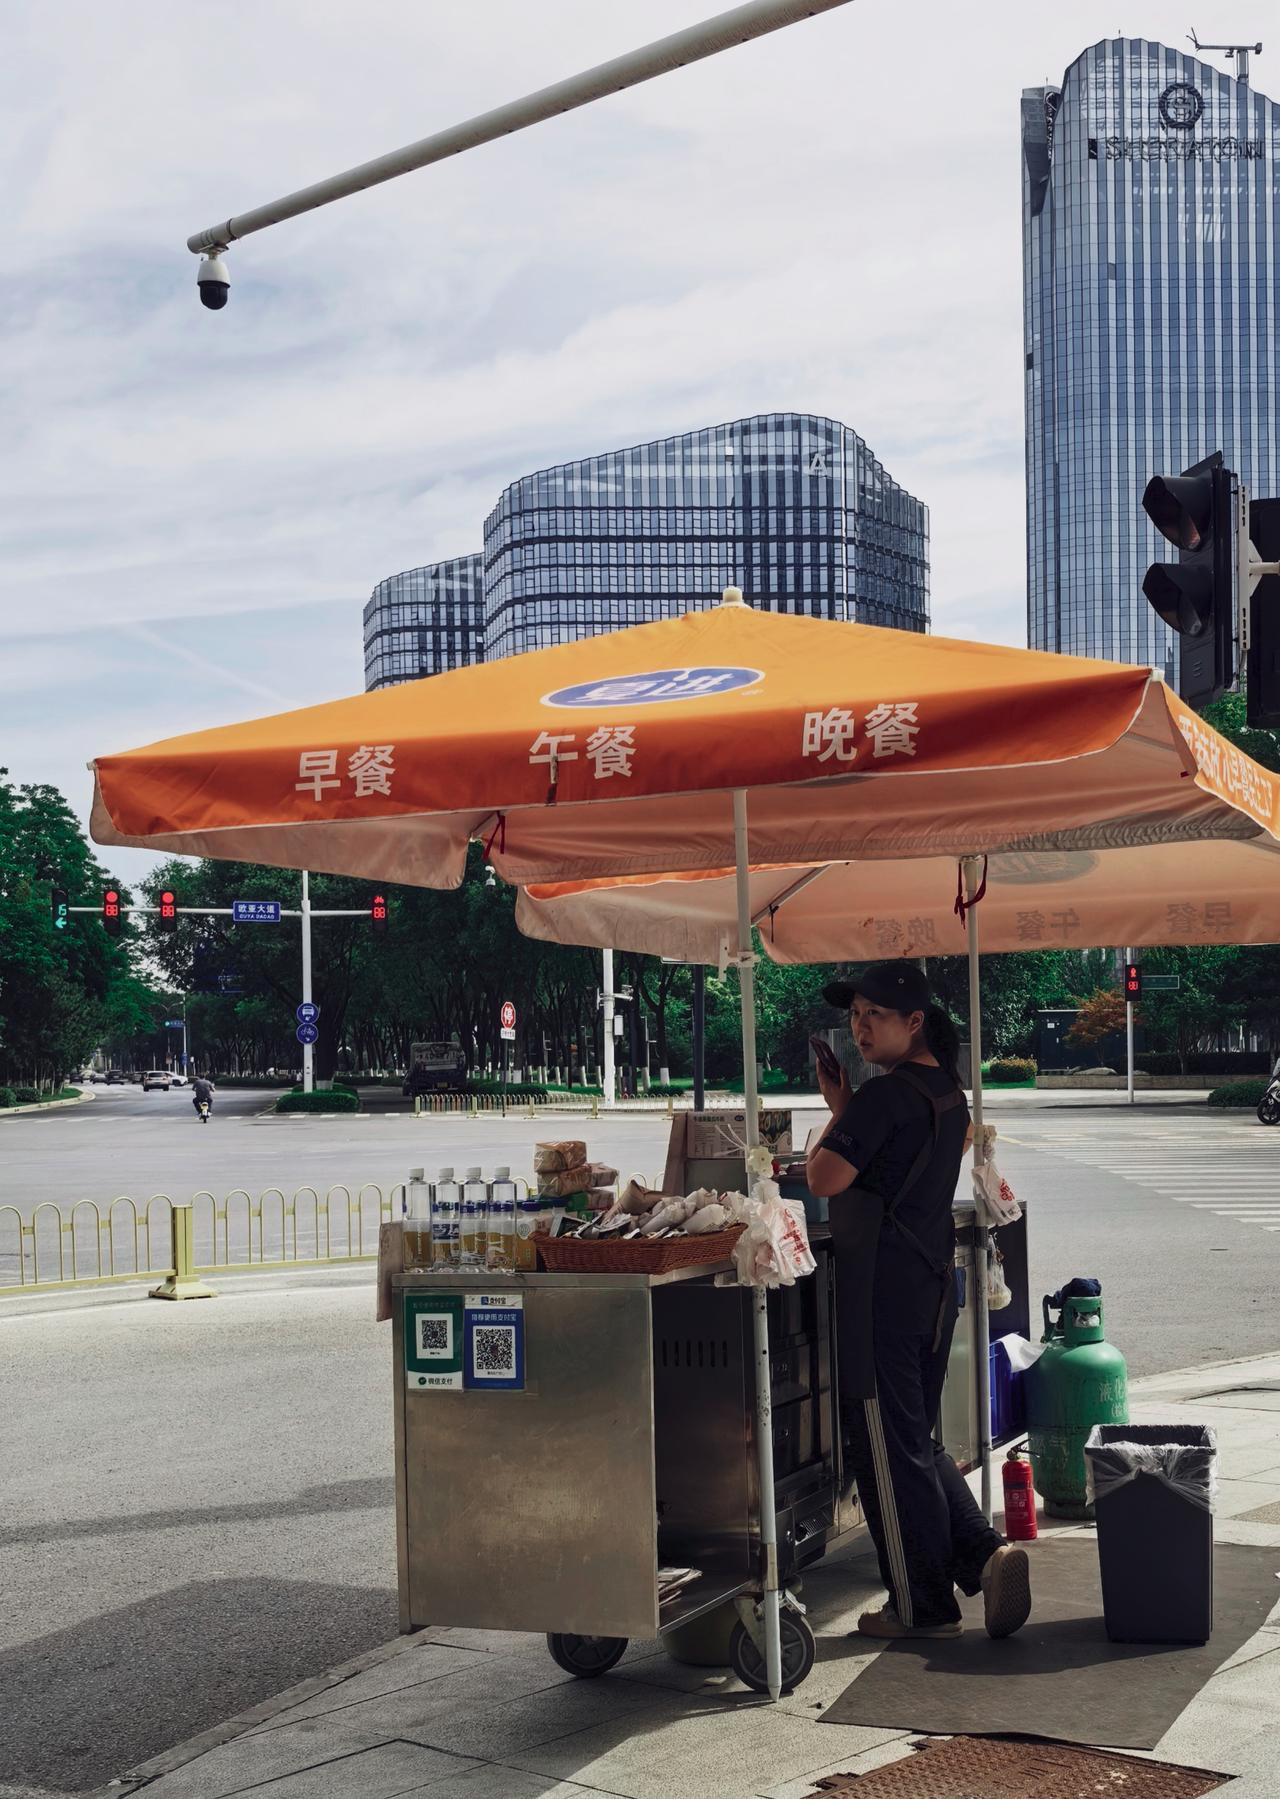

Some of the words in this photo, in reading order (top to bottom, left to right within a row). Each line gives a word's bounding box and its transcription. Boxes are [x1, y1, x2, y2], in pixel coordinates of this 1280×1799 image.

[295, 744, 396, 801] 早餐
[529, 725, 637, 783] 午餐
[801, 701, 921, 763] 晚餐
[238, 903, 275, 914] 欧亚大道
[489, 1296, 507, 1306] 支付宝
